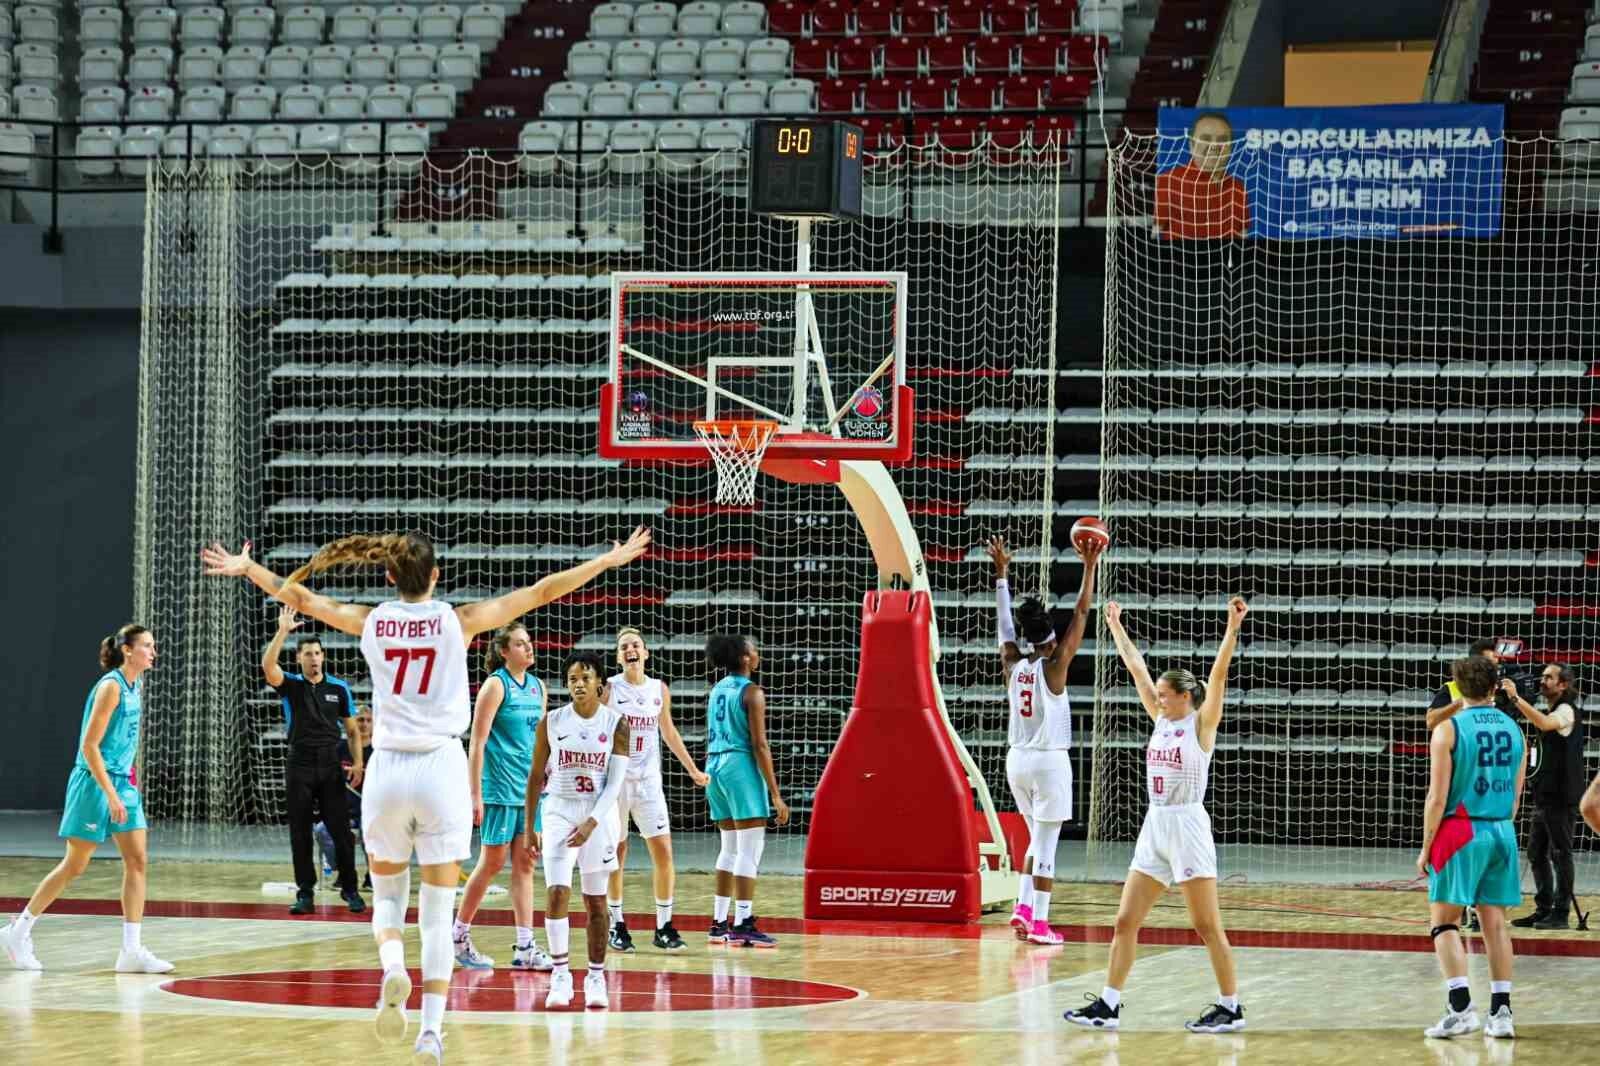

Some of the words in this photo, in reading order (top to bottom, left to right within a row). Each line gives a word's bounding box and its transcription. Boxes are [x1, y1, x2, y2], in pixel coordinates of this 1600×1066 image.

[778, 128, 811, 153] 0:0
[1245, 128, 1492, 150] SPORCULARIMIZA
[1288, 158, 1447, 182] BAŞARILAR
[1311, 183, 1422, 209] DİLERİM
[848, 430, 884, 438] WOMEN
[376, 615, 442, 638] BOYBEYİ
[384, 648, 436, 695] 77
[715, 694, 726, 722] 3
[1020, 690, 1033, 718] 3
[636, 736, 643, 751] 11
[1476, 731, 1512, 767] 22
[558, 748, 607, 768] ANTALYA
[575, 775, 594, 793] 33
[1152, 776, 1164, 794] 10
[820, 887, 957, 907] SPORTSYSTEM
